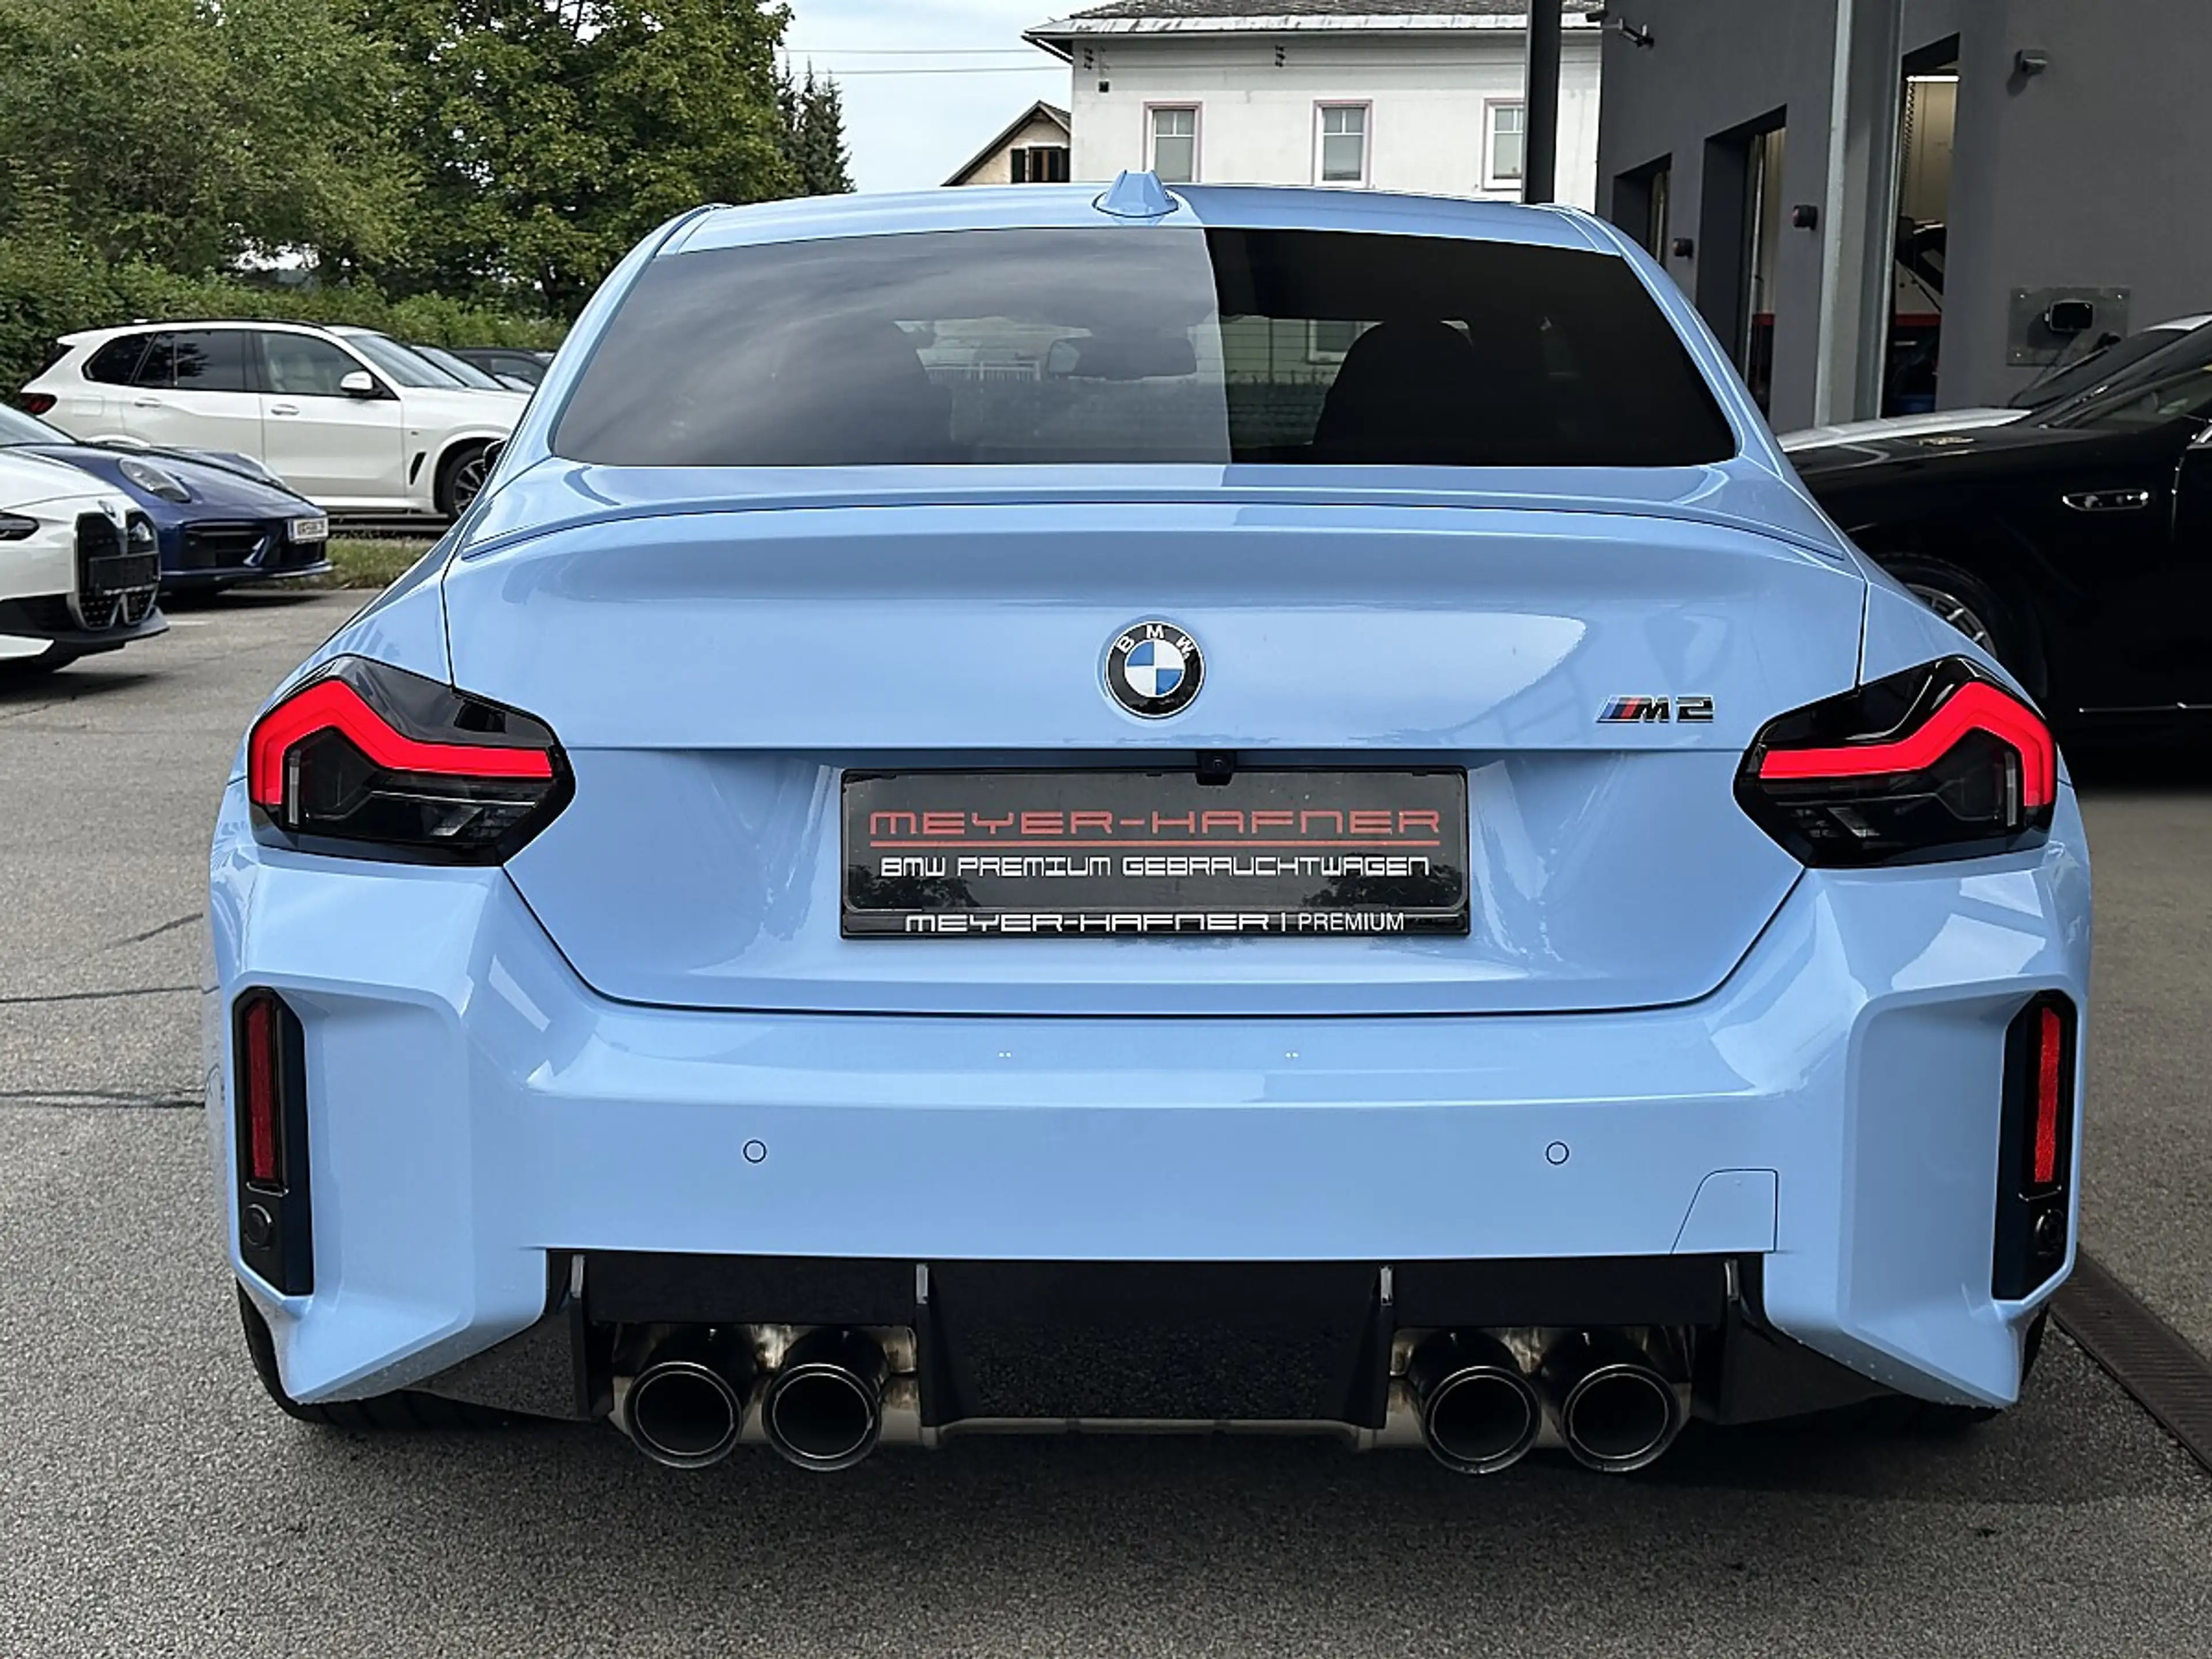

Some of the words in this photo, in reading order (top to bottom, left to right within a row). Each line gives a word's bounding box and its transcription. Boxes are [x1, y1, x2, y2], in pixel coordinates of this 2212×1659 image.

[1116, 624, 1195, 660] BMW
[1596, 695, 1714, 723] M2
[869, 810, 1440, 834] MEYER-HAFNER
[881, 857, 945, 877] BMW
[957, 857, 1111, 876] PREMIUM
[1122, 857, 1429, 876] GEBRAUCHTWAGEN
[905, 914, 1268, 932] MEYER-HAFNER
[1298, 912, 1404, 931] PREMIUM
